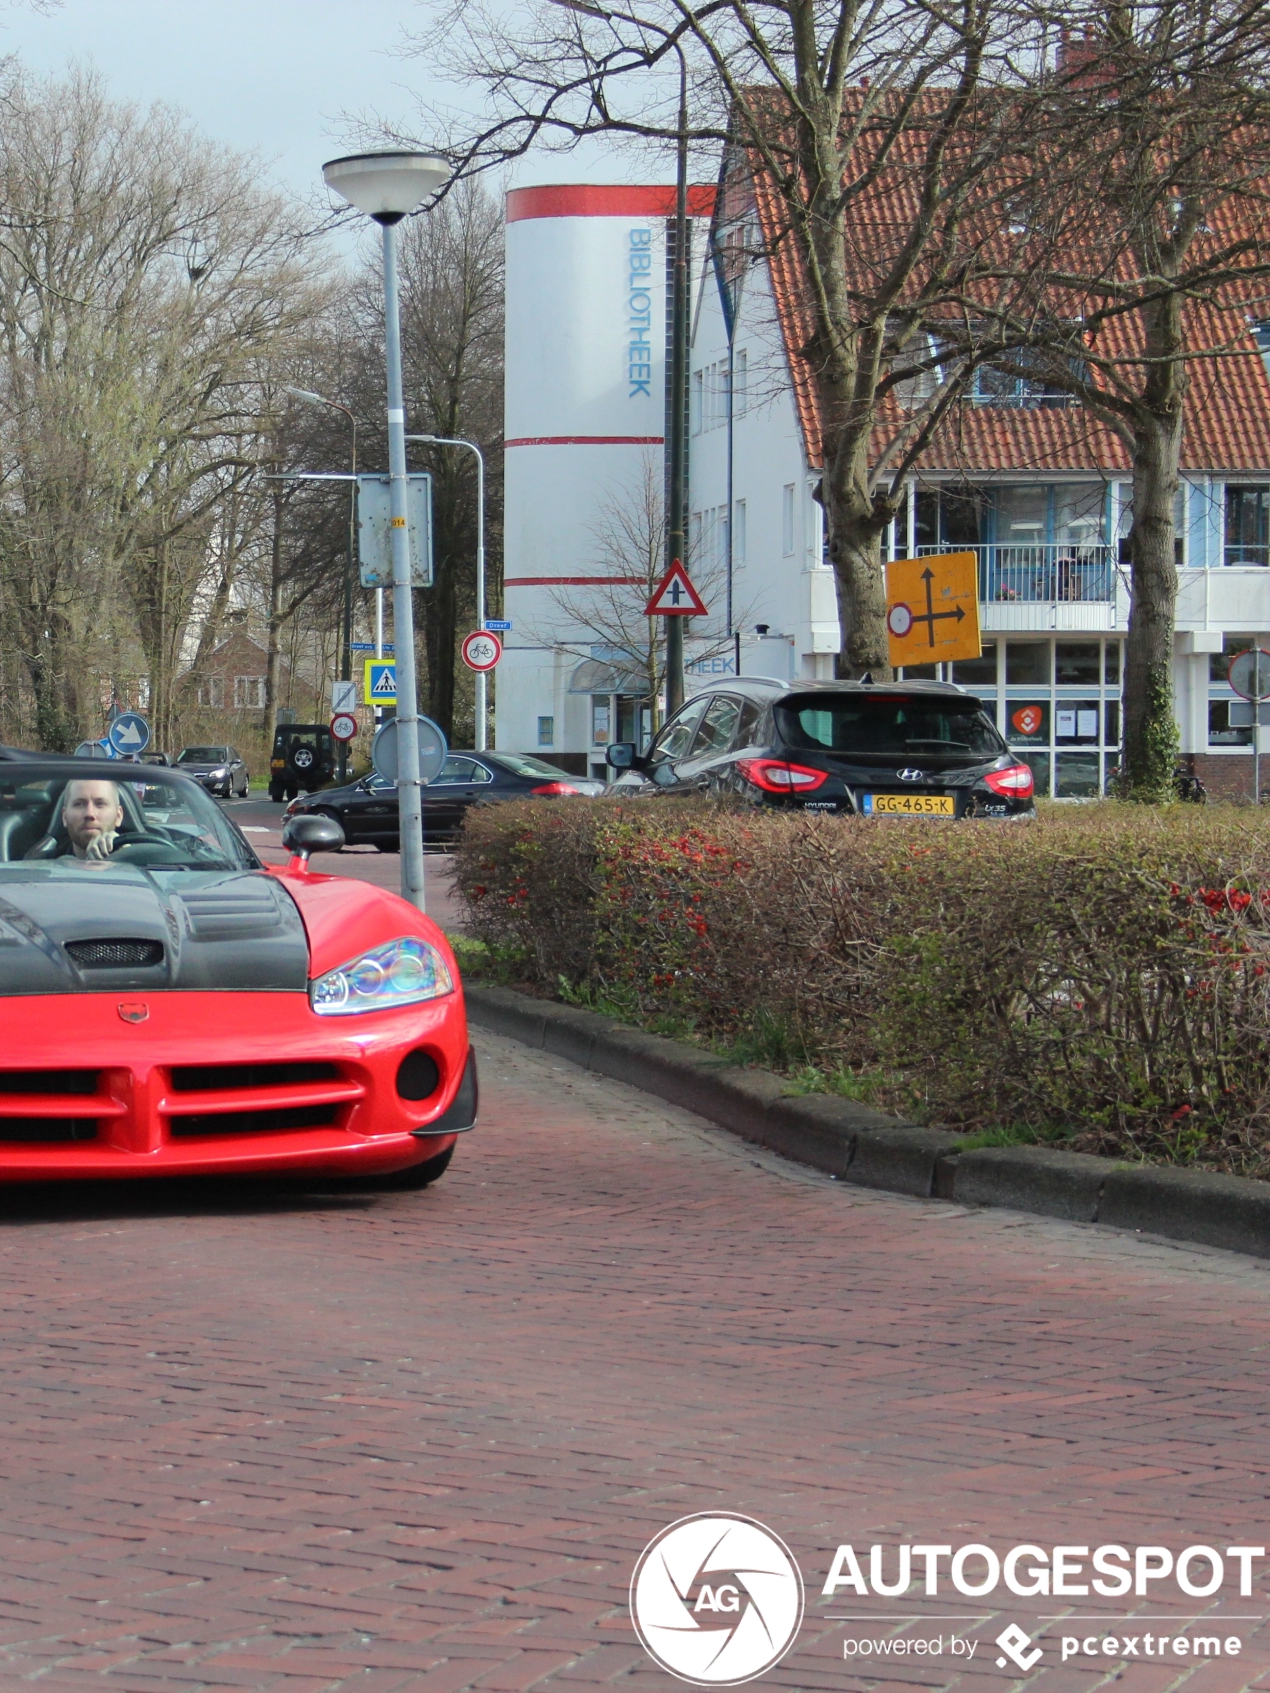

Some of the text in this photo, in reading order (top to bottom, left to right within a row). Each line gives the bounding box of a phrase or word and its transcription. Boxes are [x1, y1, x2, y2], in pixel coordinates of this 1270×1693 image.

[629, 228, 651, 398] BIBLIOTHEEK
[683, 657, 735, 674] THEEK
[876, 797, 949, 812] GG-465-K
